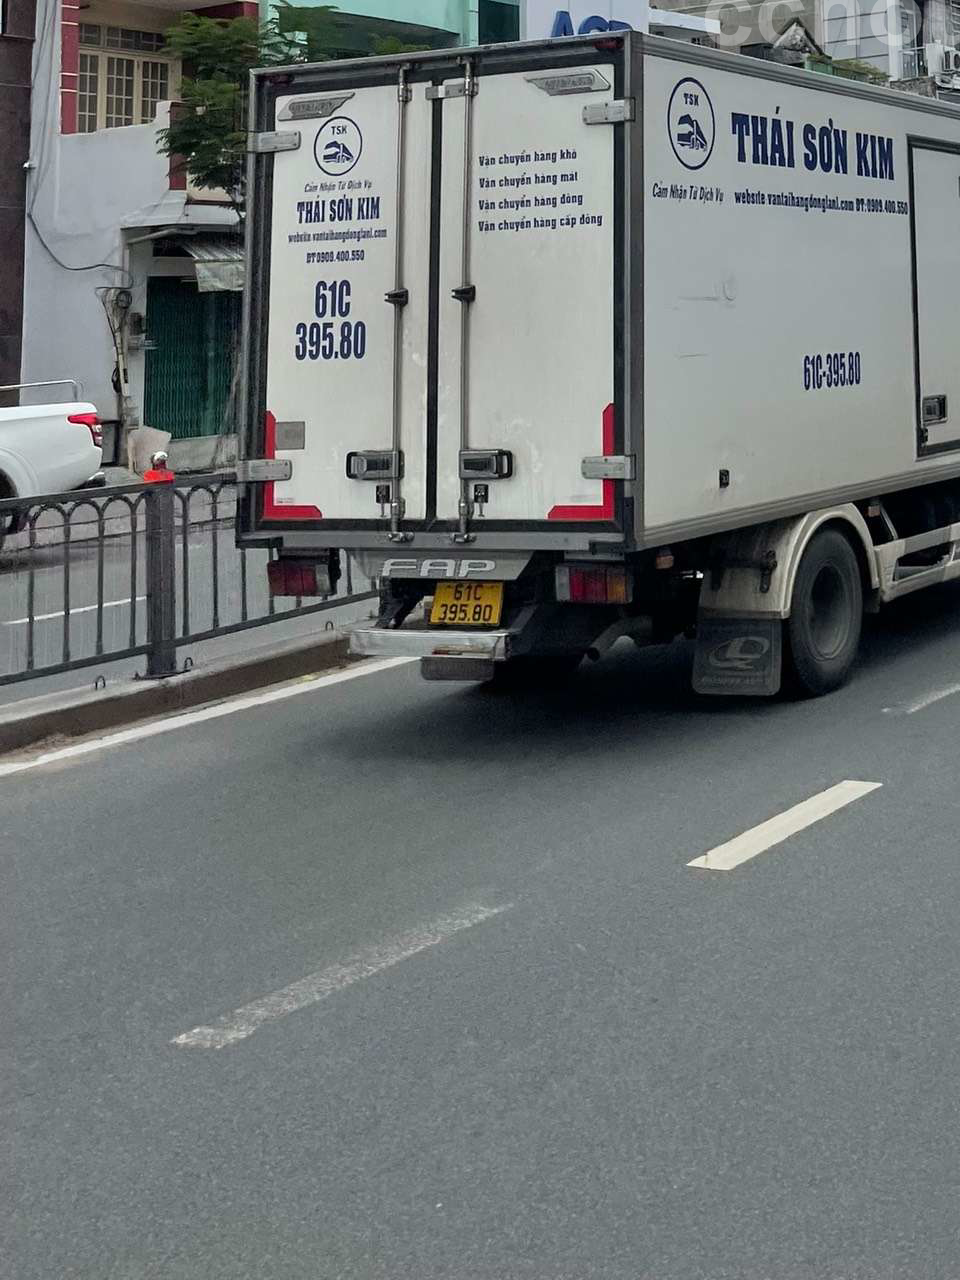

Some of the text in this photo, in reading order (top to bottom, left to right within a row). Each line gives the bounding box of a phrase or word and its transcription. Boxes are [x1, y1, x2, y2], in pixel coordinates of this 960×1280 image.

[684, 93, 699, 106] TSK
[331, 125, 347, 135] TSK
[731, 106, 895, 180] THÁI SƠN KIM
[534, 150, 557, 163] hàng
[534, 173, 557, 185] hàng
[297, 194, 380, 224] THÁI SƠN KIM
[534, 196, 557, 208] hàng
[533, 217, 556, 229] hàng
[315, 280, 351, 318] 61C
[295, 321, 366, 360] 395.80
[803, 351, 861, 390] 61C-395.80
[454, 583, 484, 601] 61C
[439, 604, 493, 621] 395.80
